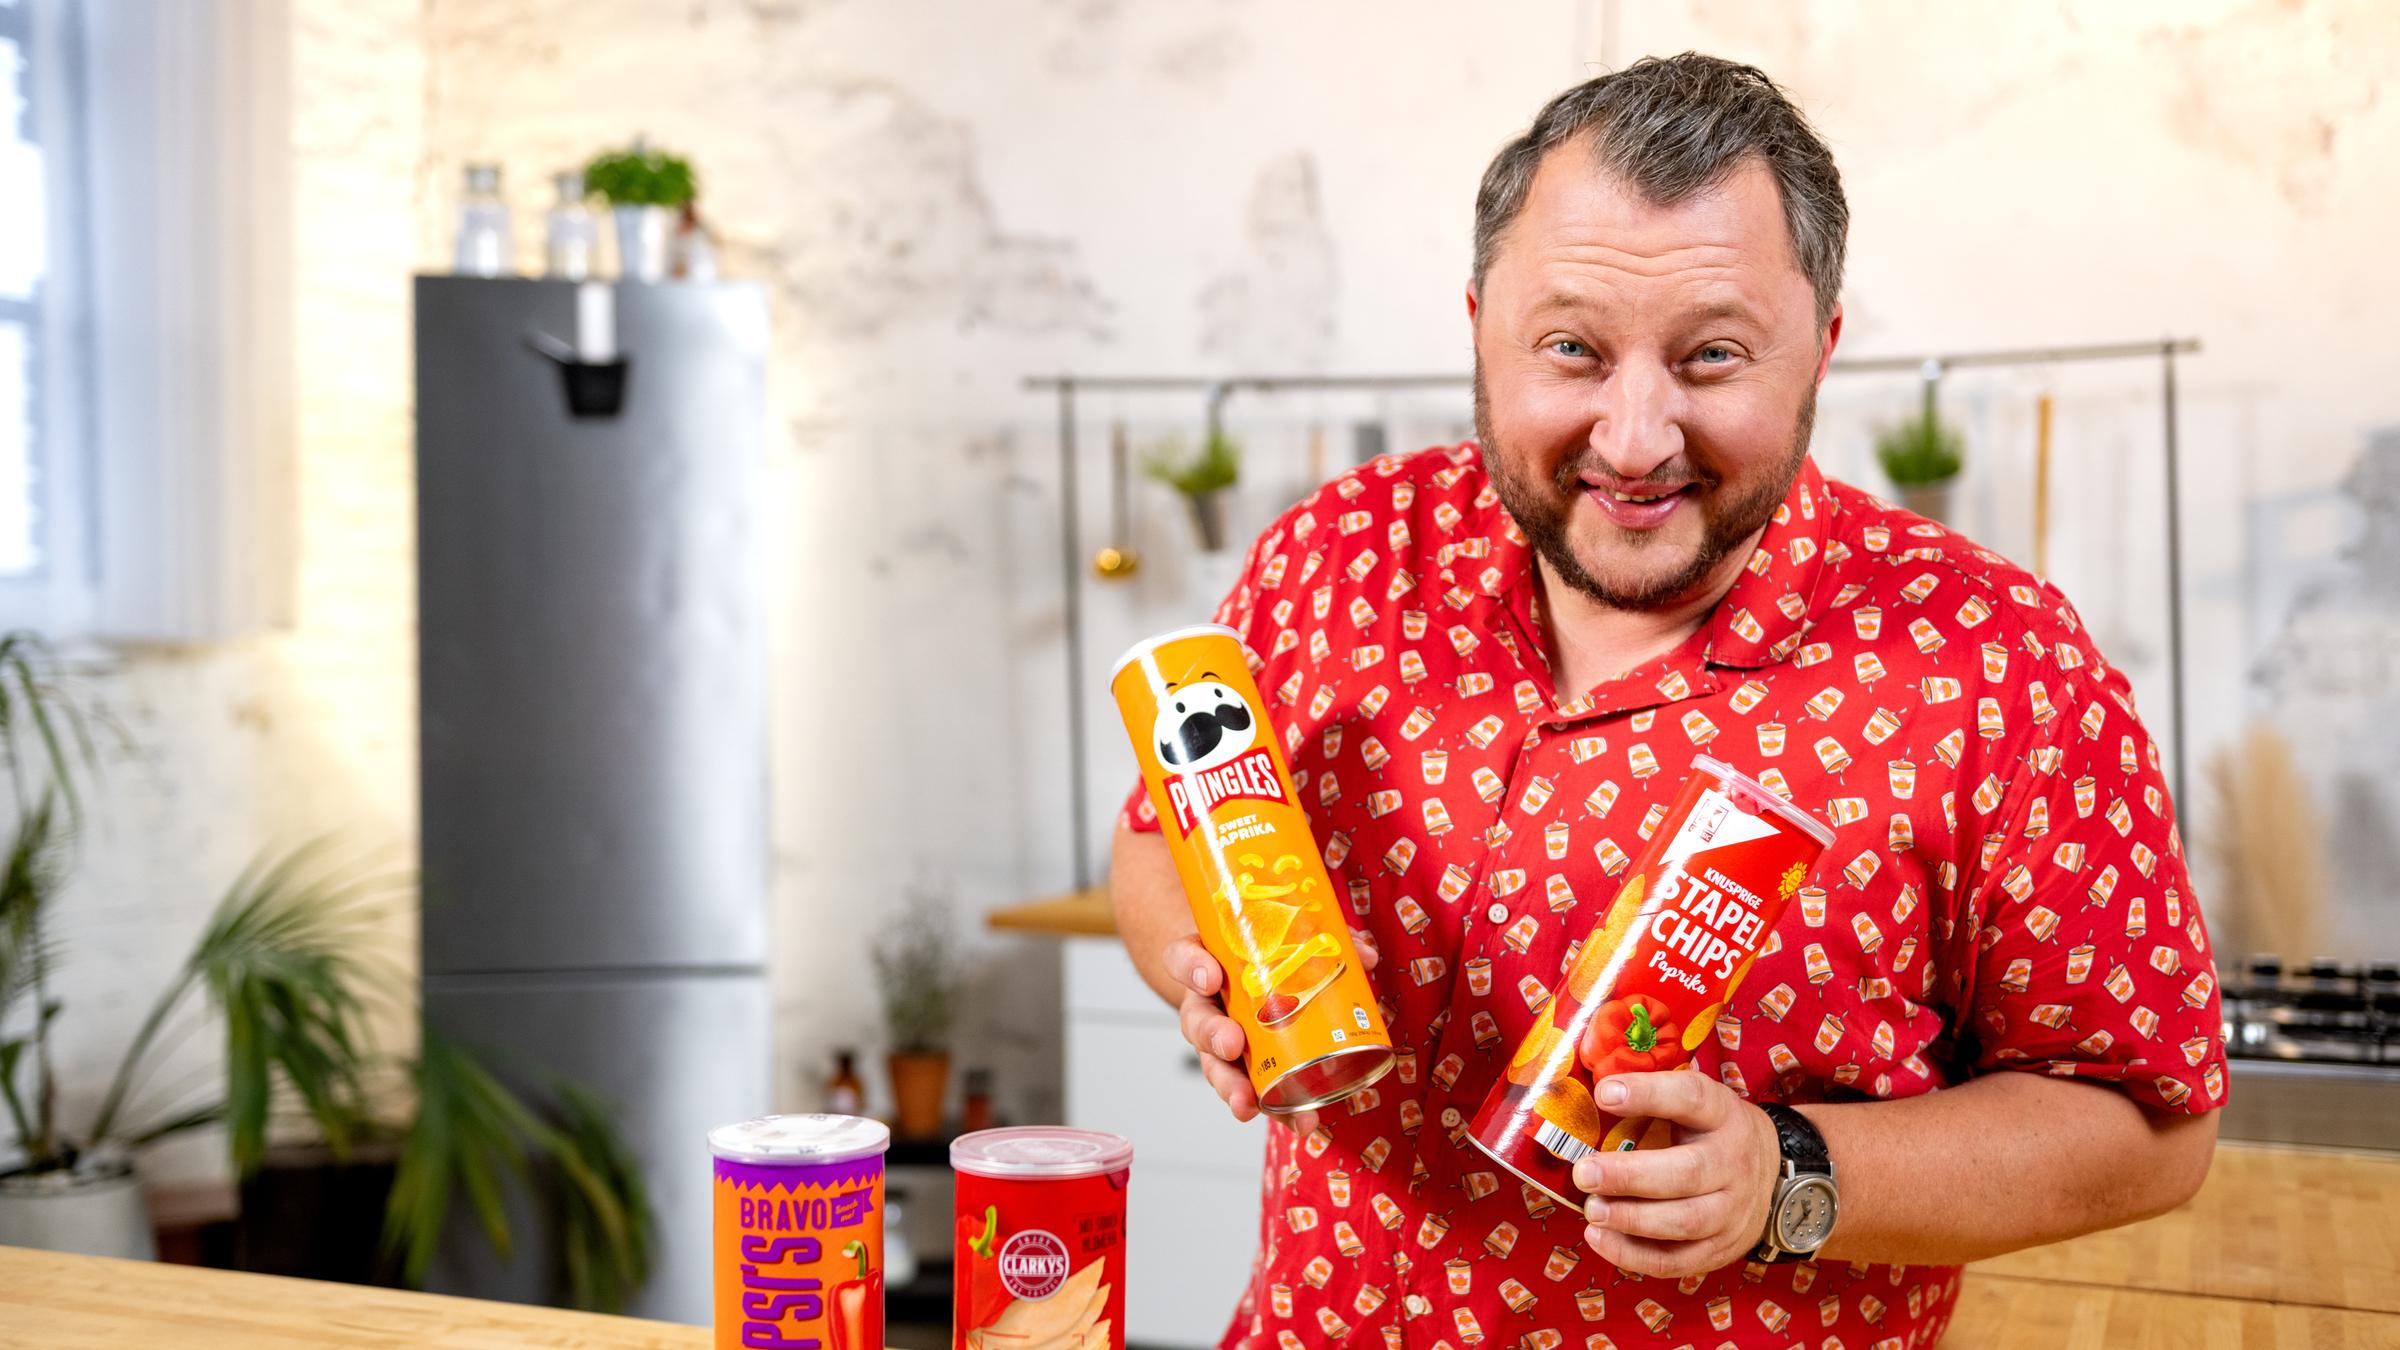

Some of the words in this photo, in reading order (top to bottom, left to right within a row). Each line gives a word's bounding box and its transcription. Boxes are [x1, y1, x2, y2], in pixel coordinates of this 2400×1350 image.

[1217, 822, 1276, 848] APRIKA
[1218, 814, 1257, 834] SWEET
[1703, 867, 1764, 910] KNUSPRIGE
[1660, 868, 1766, 952] STAPEL
[1651, 909, 1742, 980] CHIPS
[1647, 950, 1708, 995] Paprika
[740, 1197, 827, 1231] BRAVO
[1003, 1256, 1065, 1275] CLARKYS
